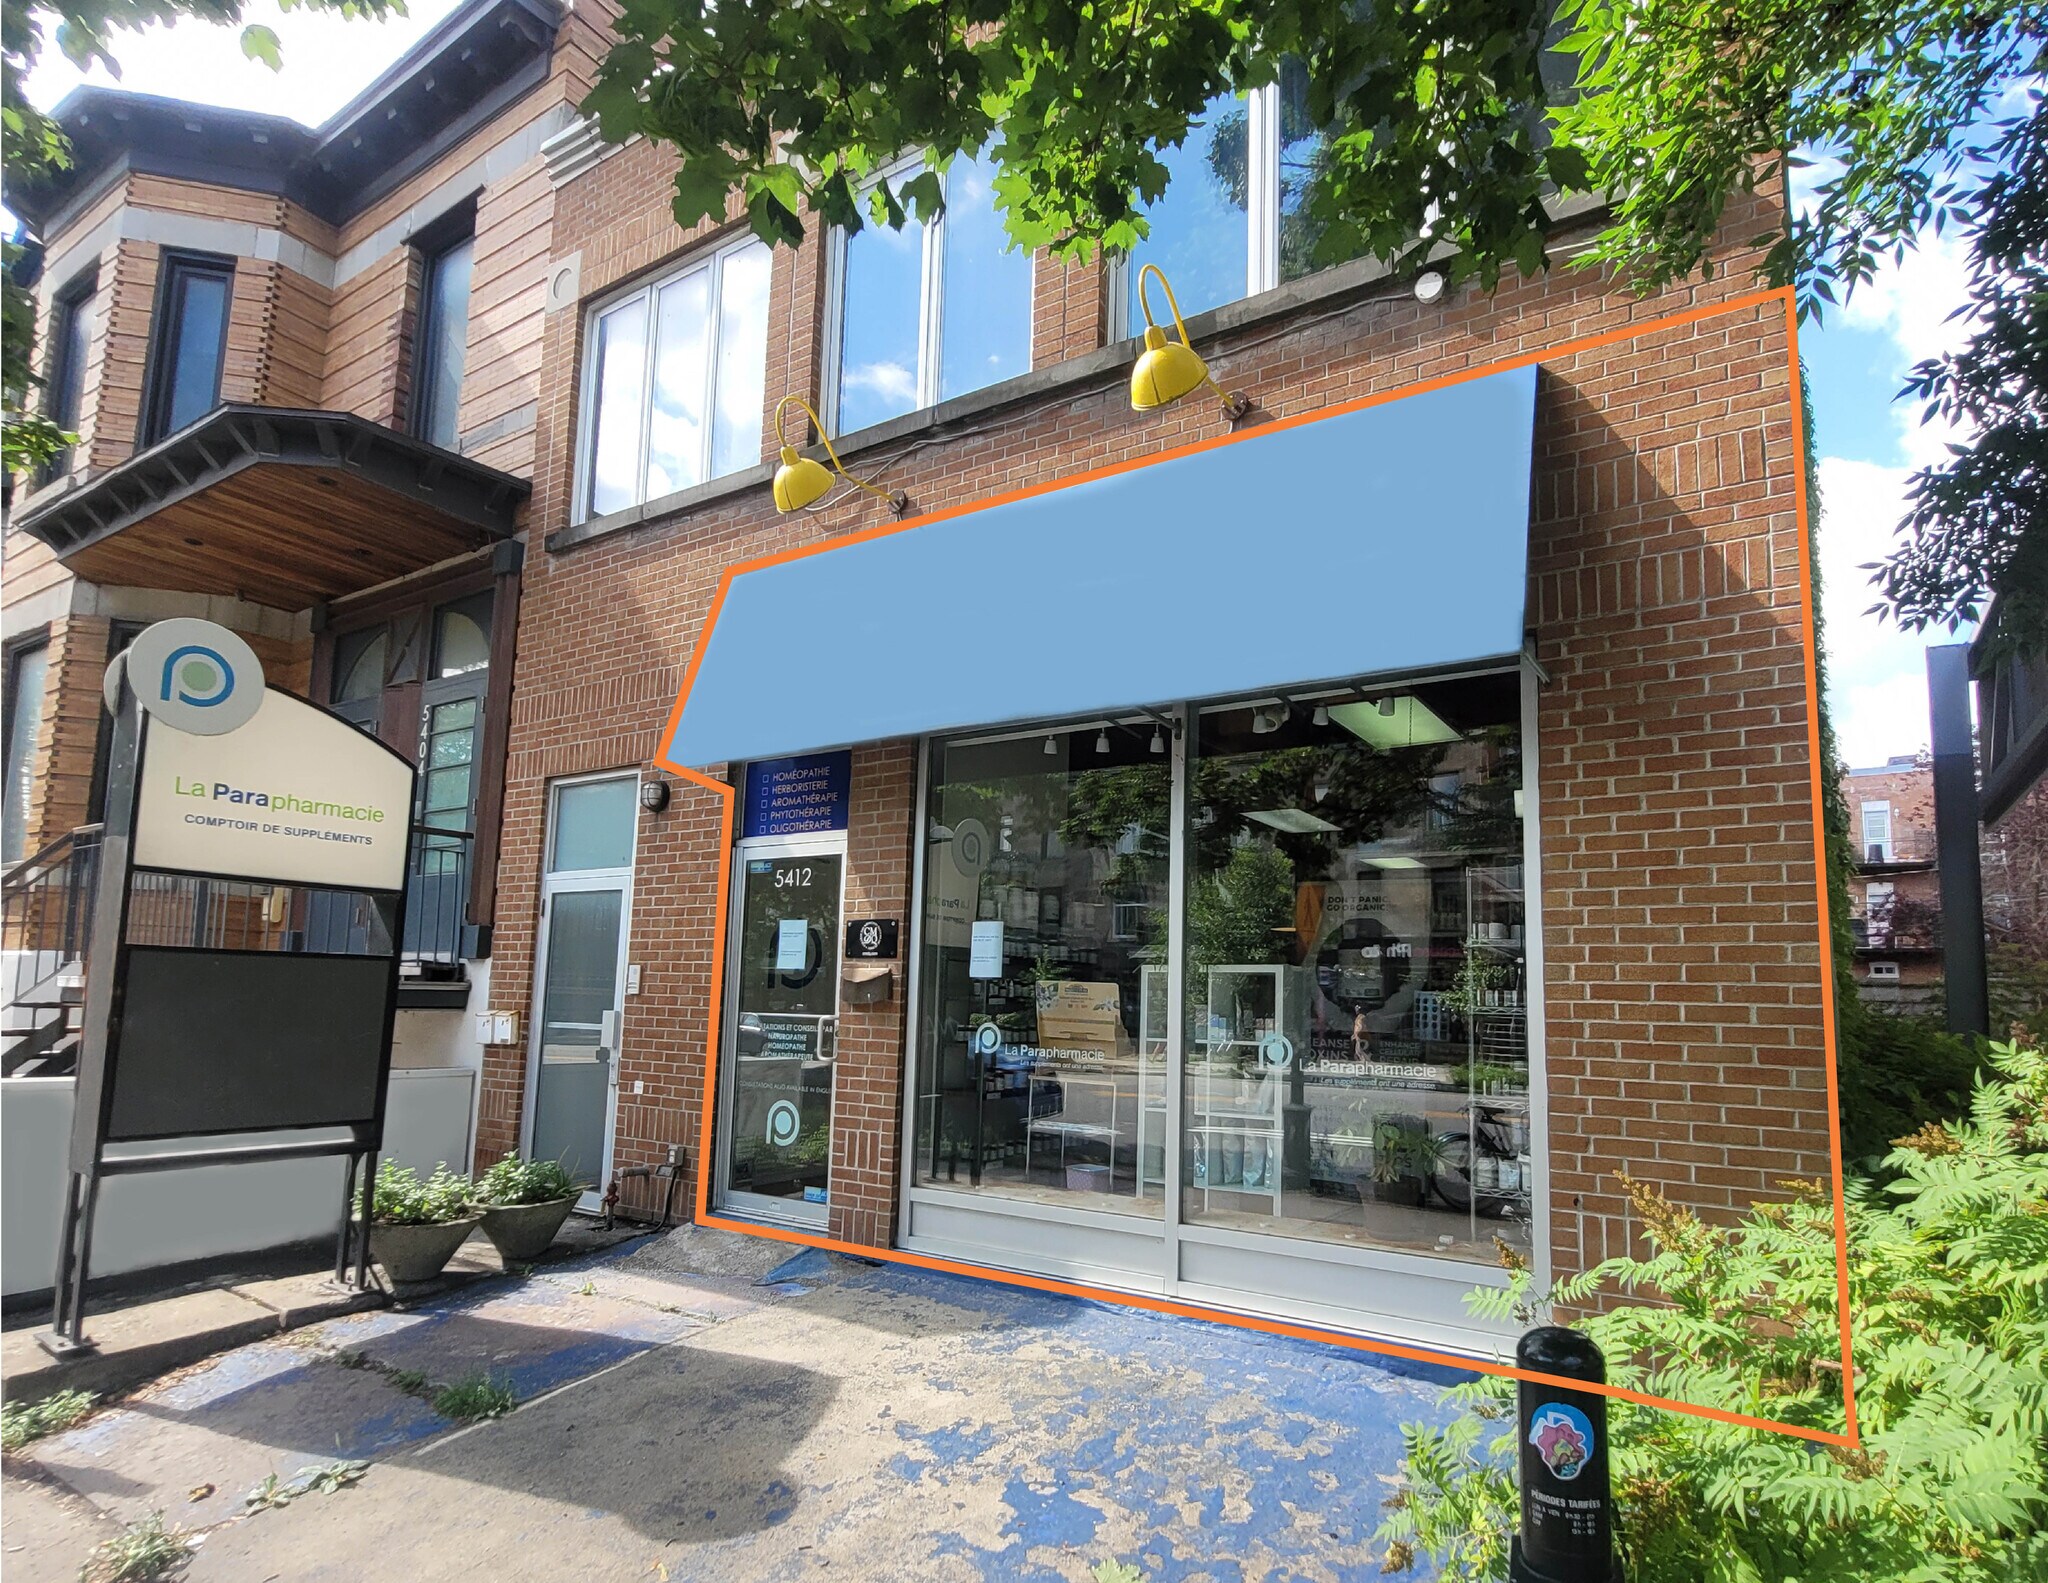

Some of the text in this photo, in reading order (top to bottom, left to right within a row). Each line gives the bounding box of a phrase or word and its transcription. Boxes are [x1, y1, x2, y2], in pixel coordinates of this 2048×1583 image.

[418, 704, 430, 777] 5404
[772, 766, 831, 782] HOMÉOPATHIE
[771, 779, 829, 795] HERBORISTERIE
[174, 776, 385, 823] La Parapharmacie
[771, 791, 838, 807] AROMATHÉRAPIE
[770, 806, 832, 820] PHYTOTHÉRAPIE
[184, 813, 373, 846] COMPTOIR DE SUPPLÉMENTS
[769, 819, 832, 834] OLIGOTHÉRAPIE
[774, 867, 812, 888] 5412
[1326, 904, 1340, 912] GO
[787, 1023, 793, 1032] ET
[1005, 1043, 1105, 1061] La Parapharmacie
[1299, 1058, 1437, 1078] La Parapharmacie
[1320, 1076, 1333, 1085] Les
[1531, 1488, 1601, 1509] PÉRIODES TARIFÉES
